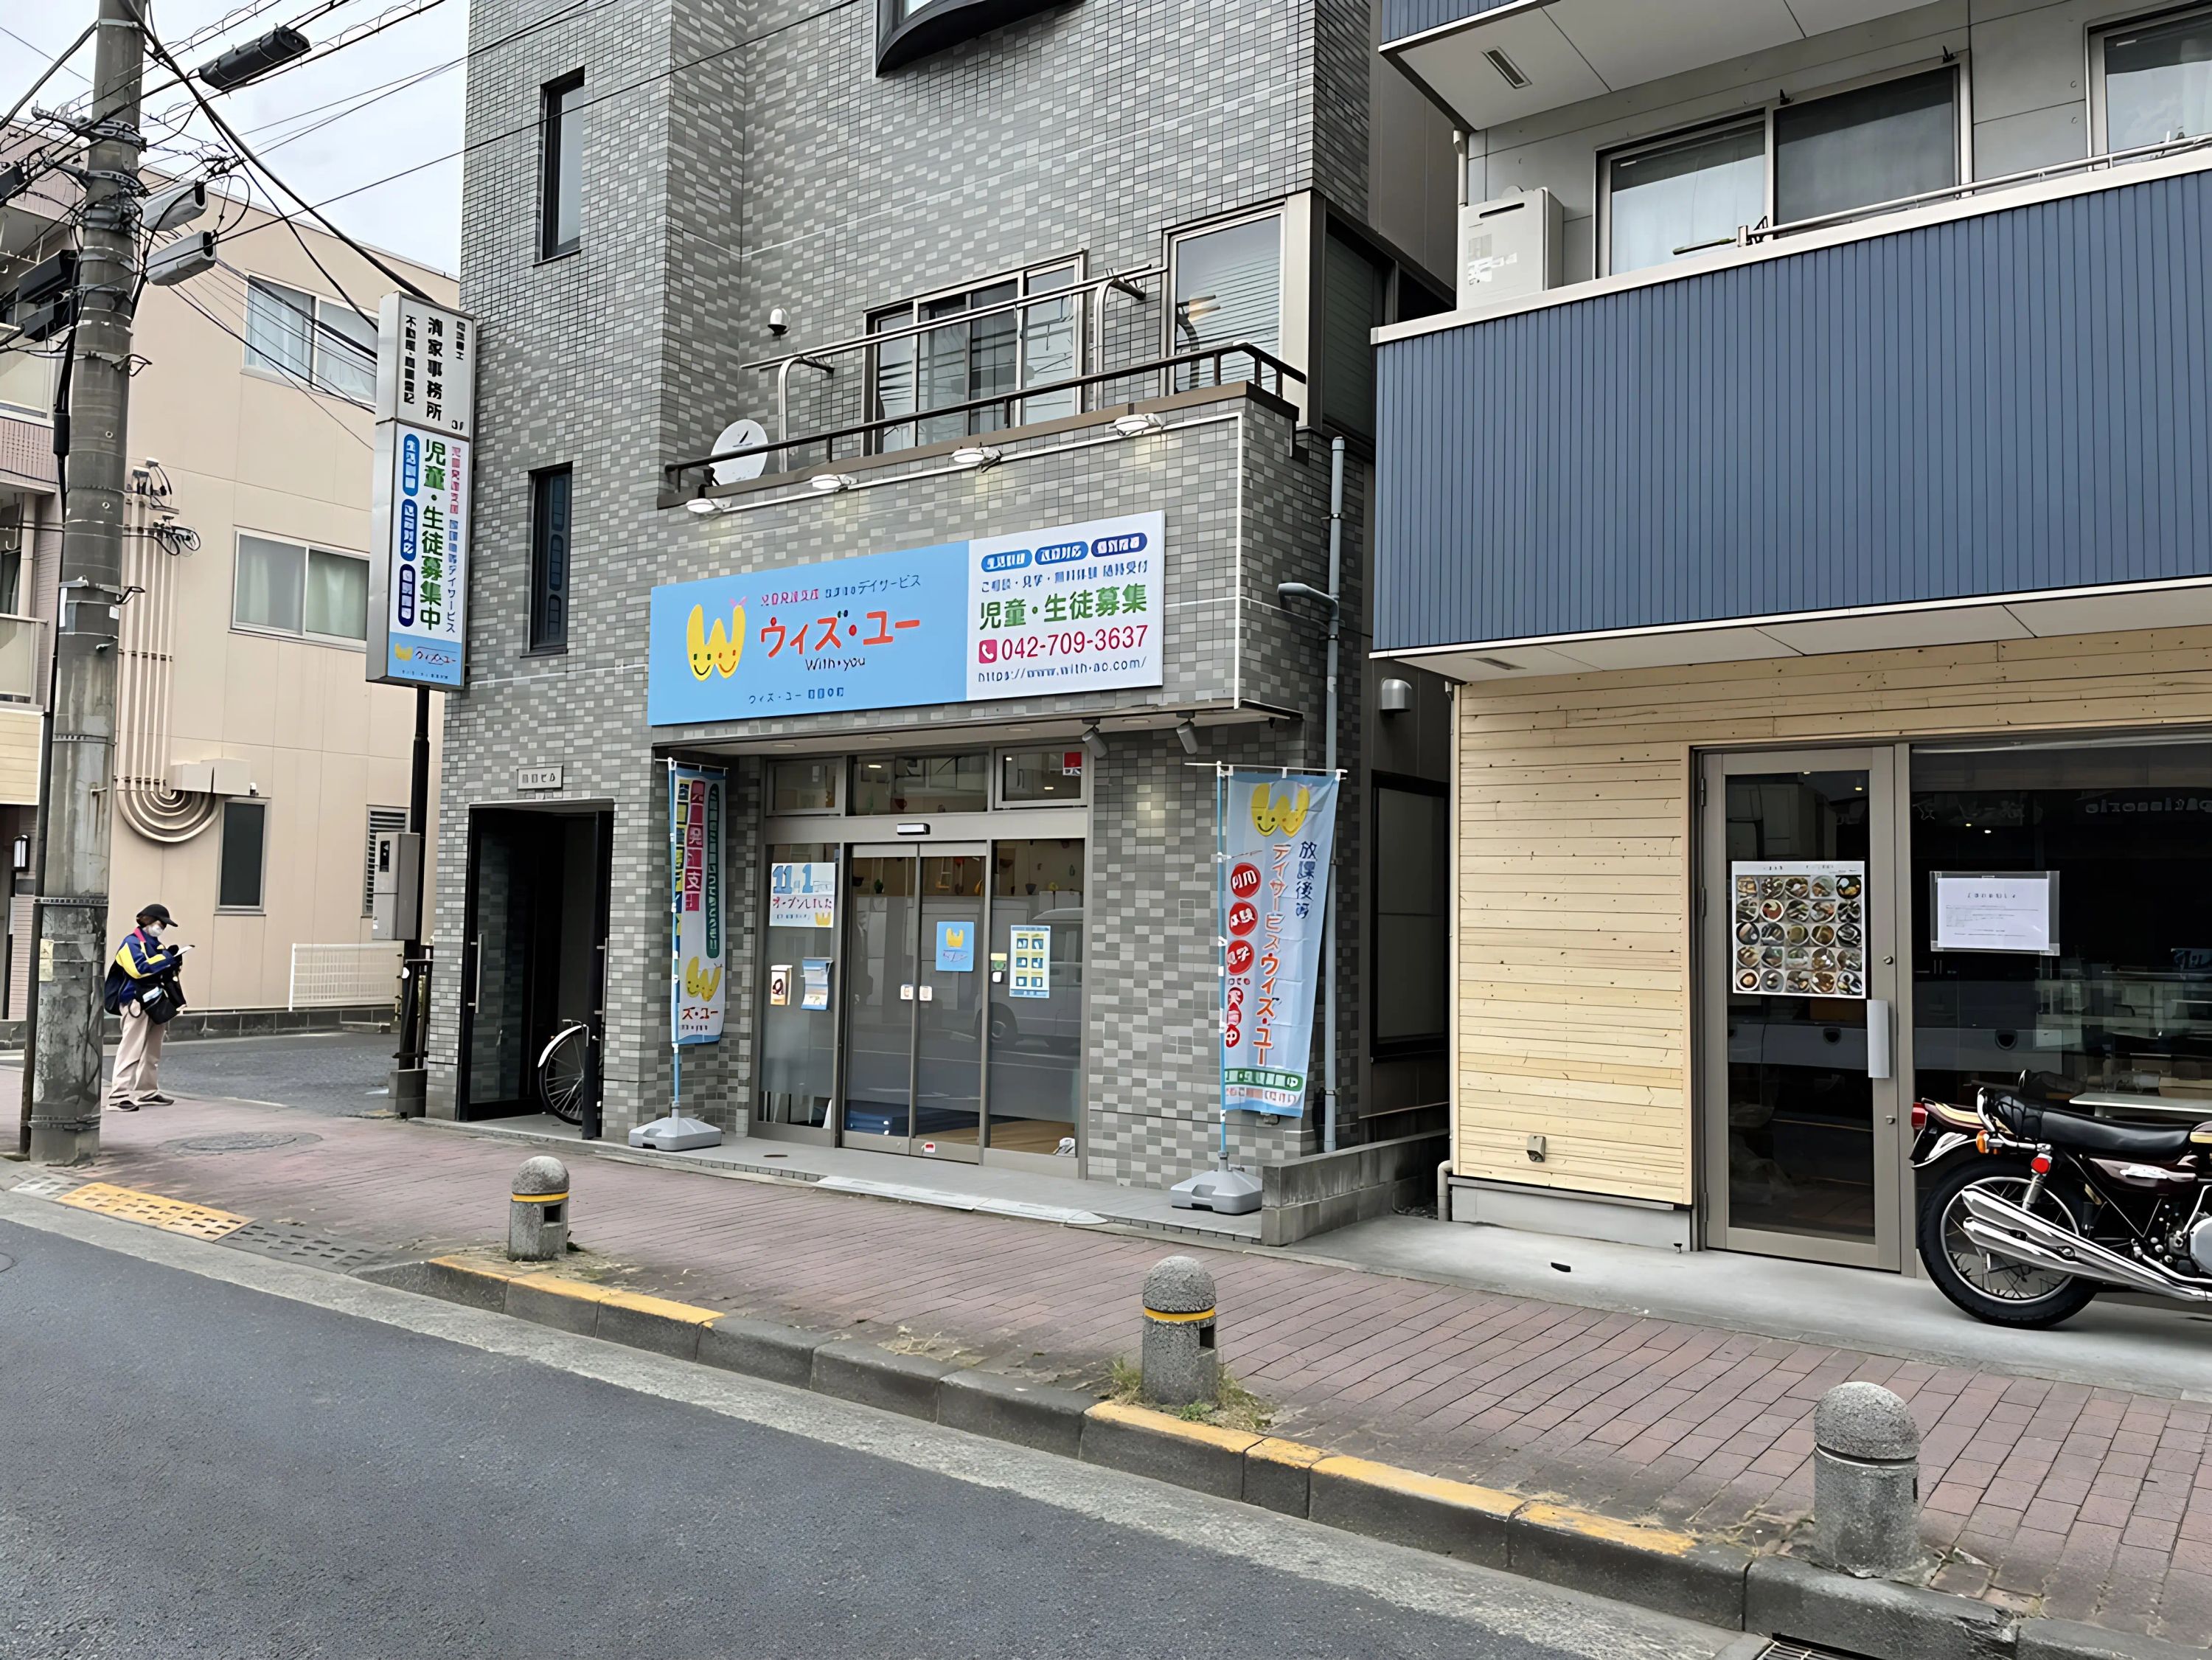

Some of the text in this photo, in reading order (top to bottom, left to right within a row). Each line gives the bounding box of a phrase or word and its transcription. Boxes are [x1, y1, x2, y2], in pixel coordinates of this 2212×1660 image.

[420, 438, 446, 631] 児童・生徒募集中
[979, 583, 1148, 631] 児童・生徒募集
[760, 609, 921, 658] ウィズ・ユー
[1001, 625, 1149, 661] 042-709-3637
